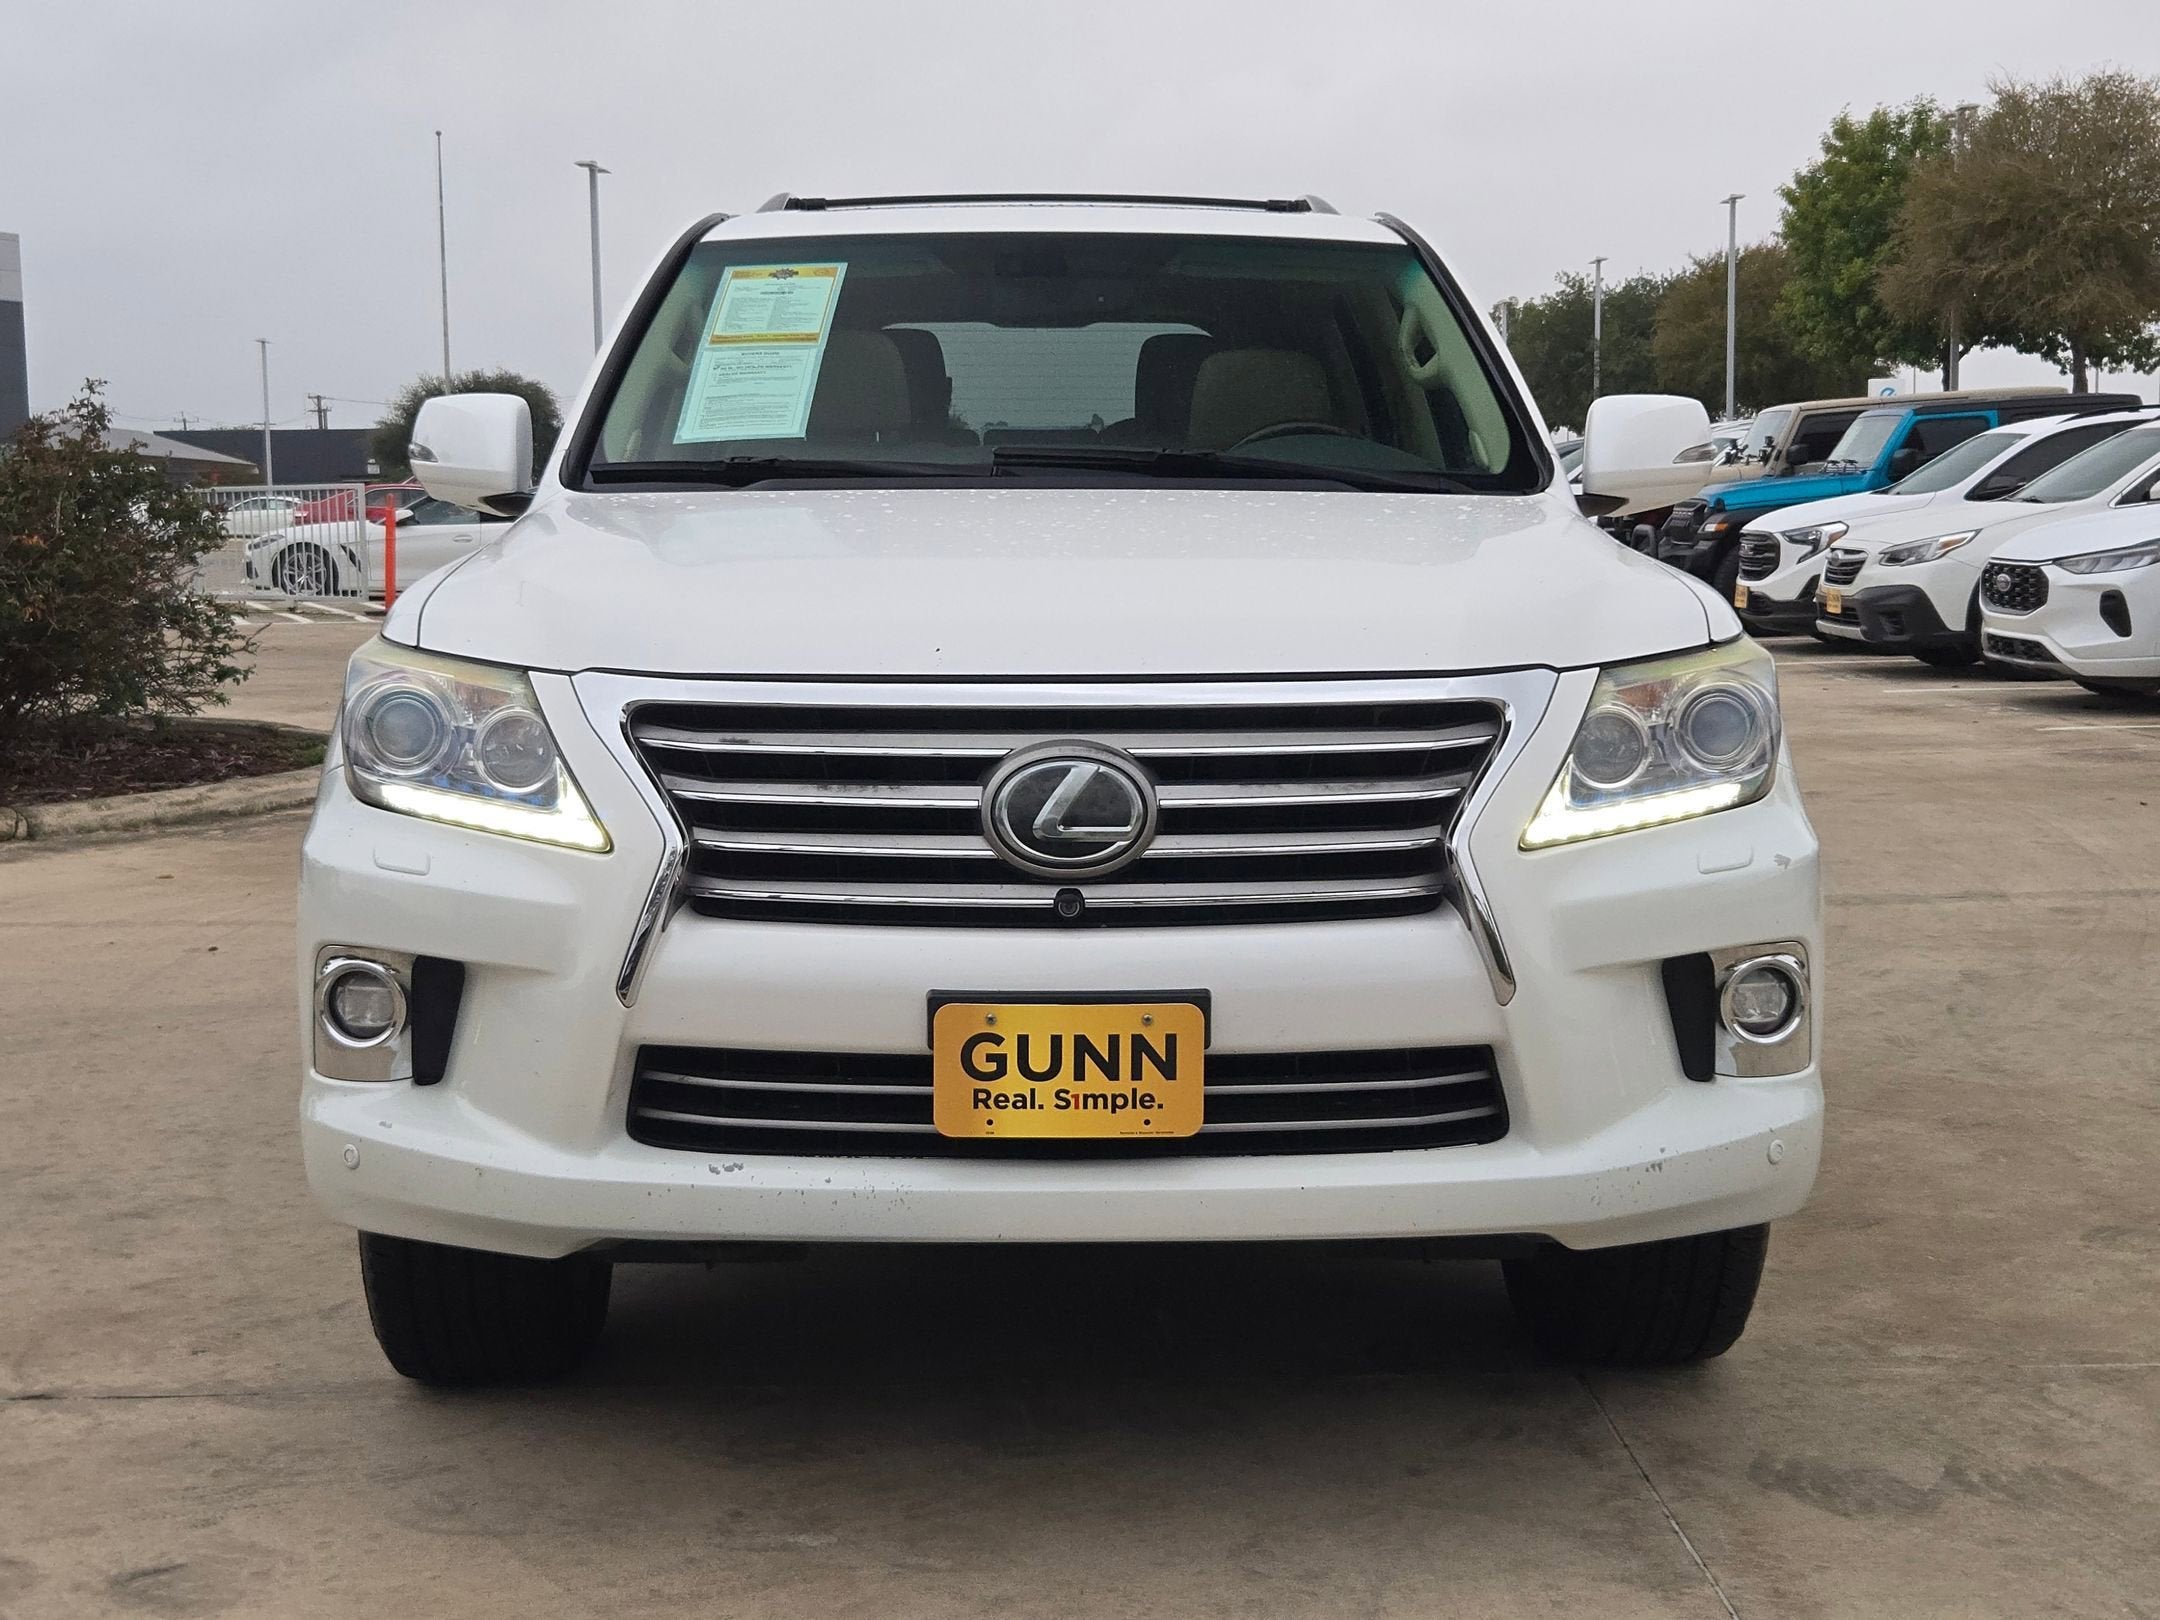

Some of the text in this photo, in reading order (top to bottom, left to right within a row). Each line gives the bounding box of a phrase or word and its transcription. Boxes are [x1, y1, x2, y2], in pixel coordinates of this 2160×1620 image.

[960, 1032, 1178, 1082] GUNN
[972, 1088, 1164, 1114] Real. S1mple.
